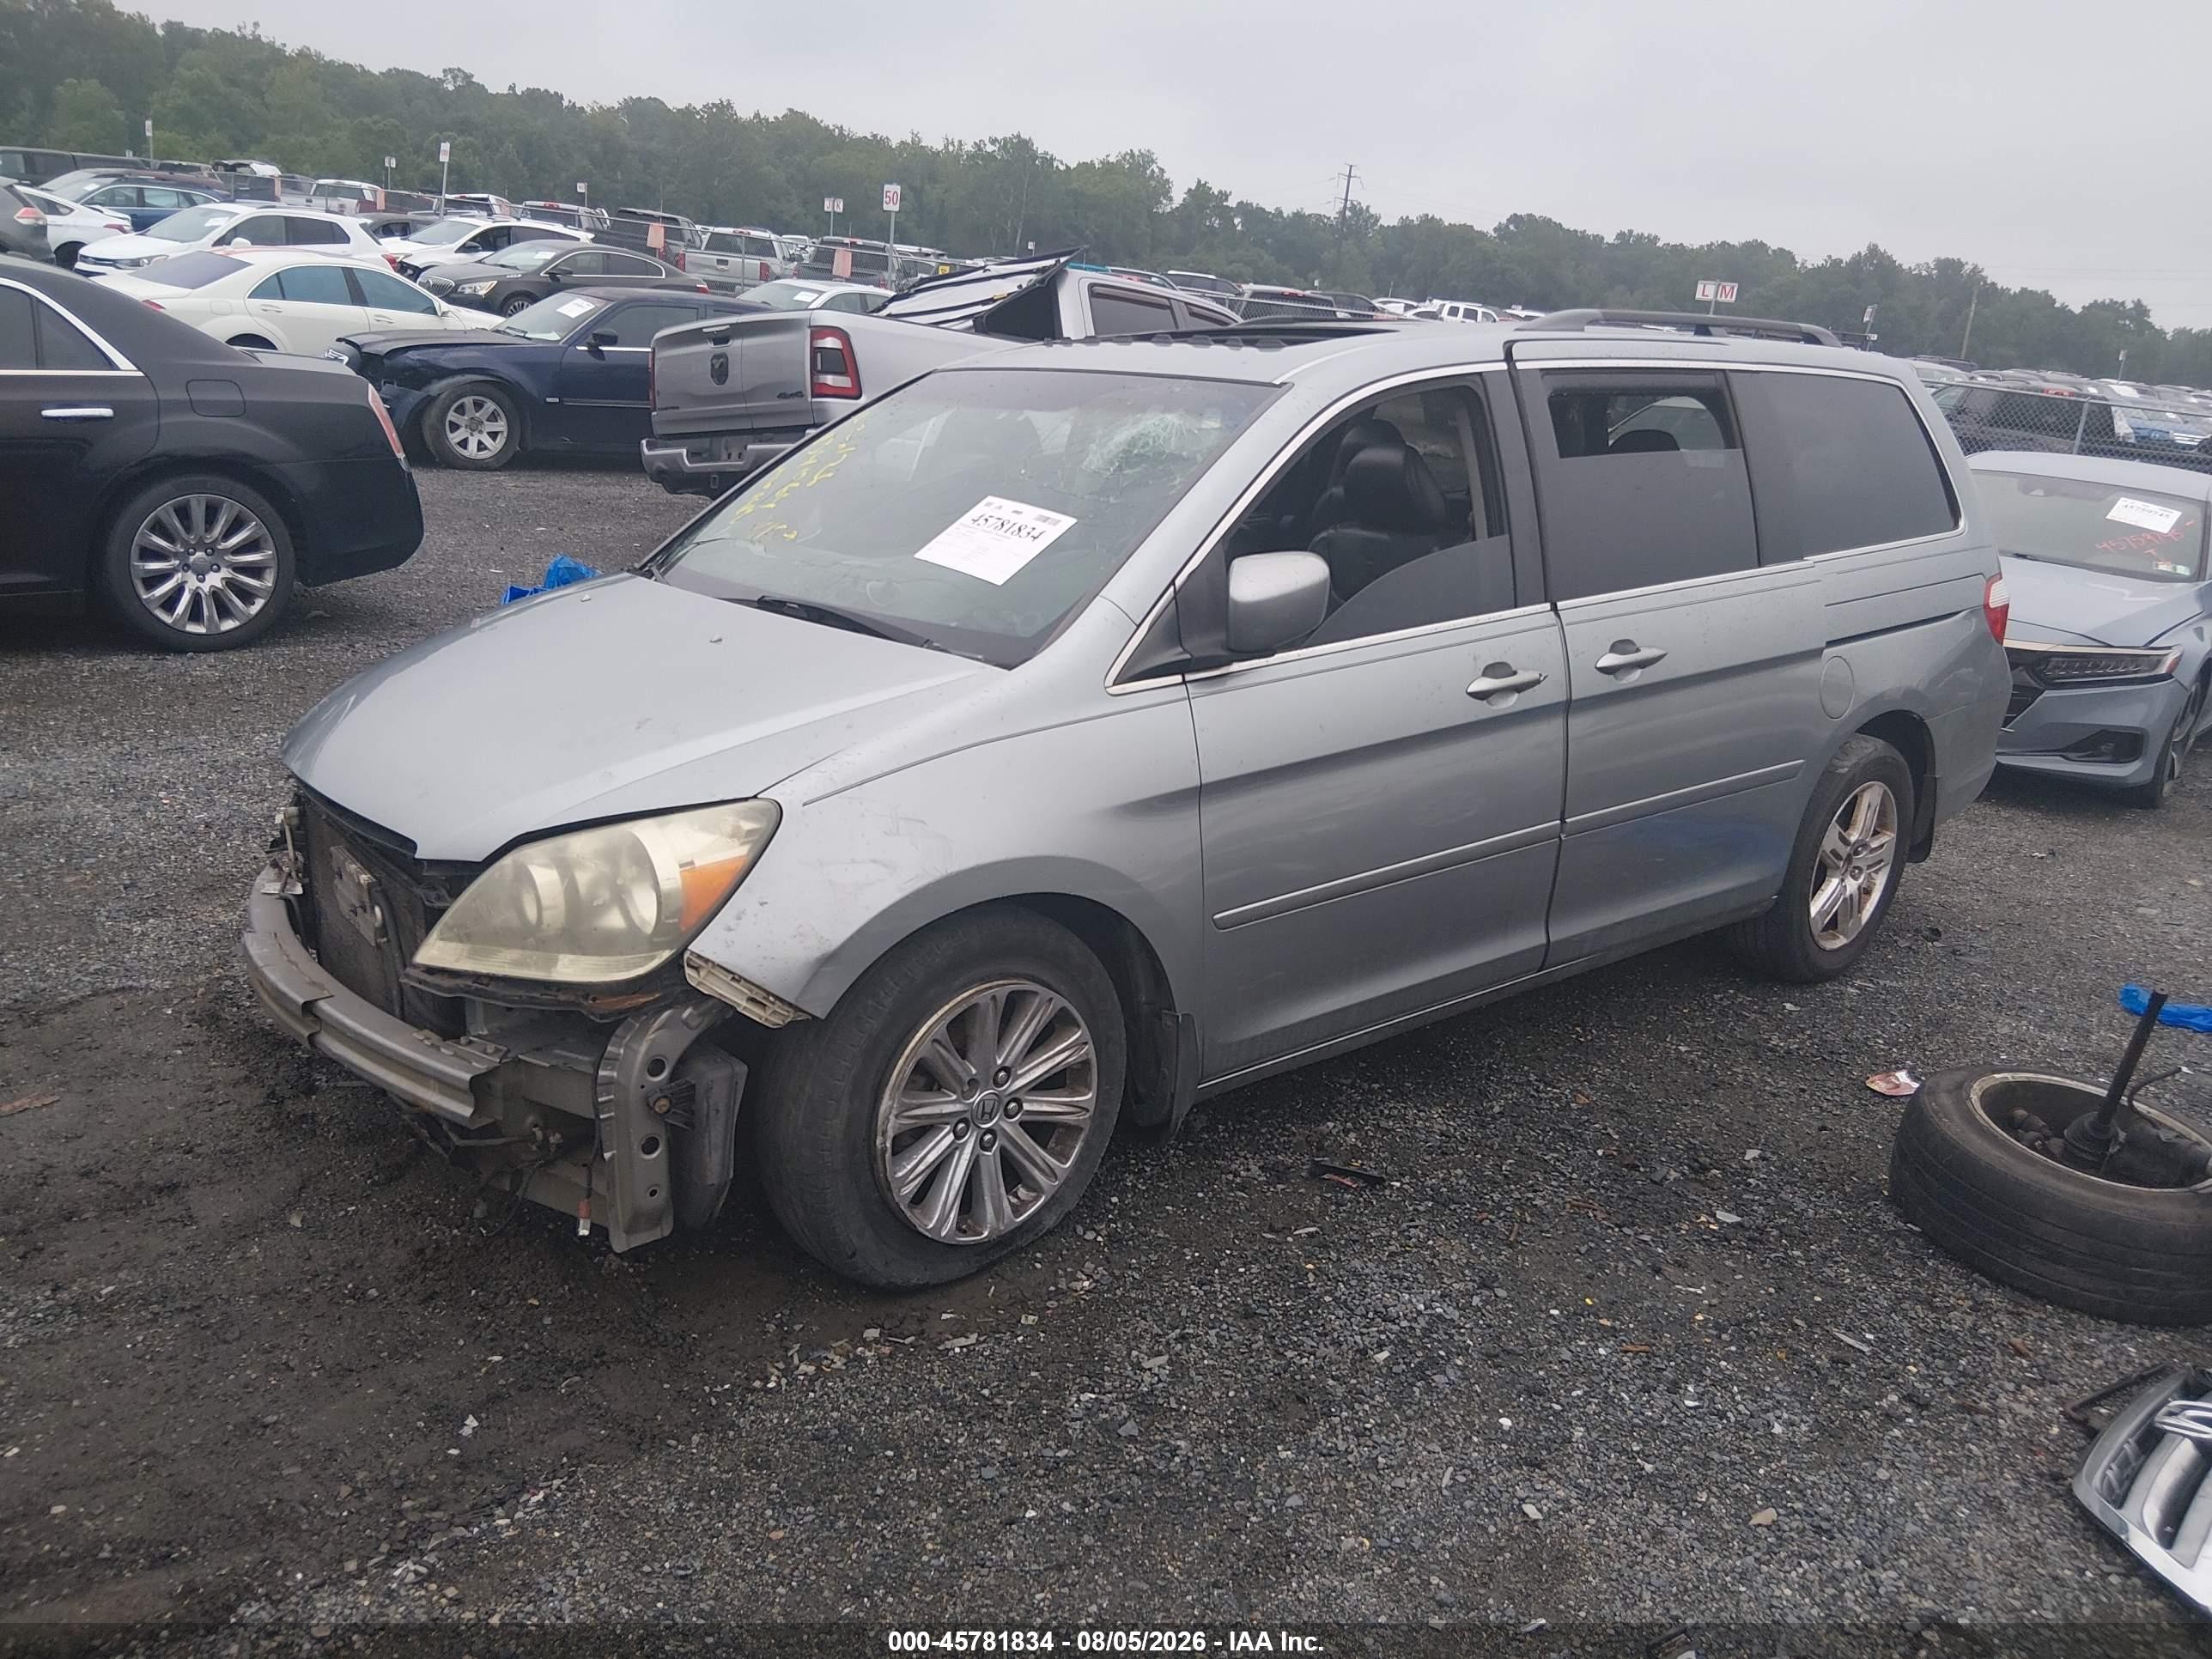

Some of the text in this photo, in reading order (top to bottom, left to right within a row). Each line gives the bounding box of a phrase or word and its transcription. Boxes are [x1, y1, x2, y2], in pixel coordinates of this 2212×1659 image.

[884, 190, 899, 206] 50
[1701, 283, 1735, 300] L M
[971, 514, 1047, 542] 45781834
